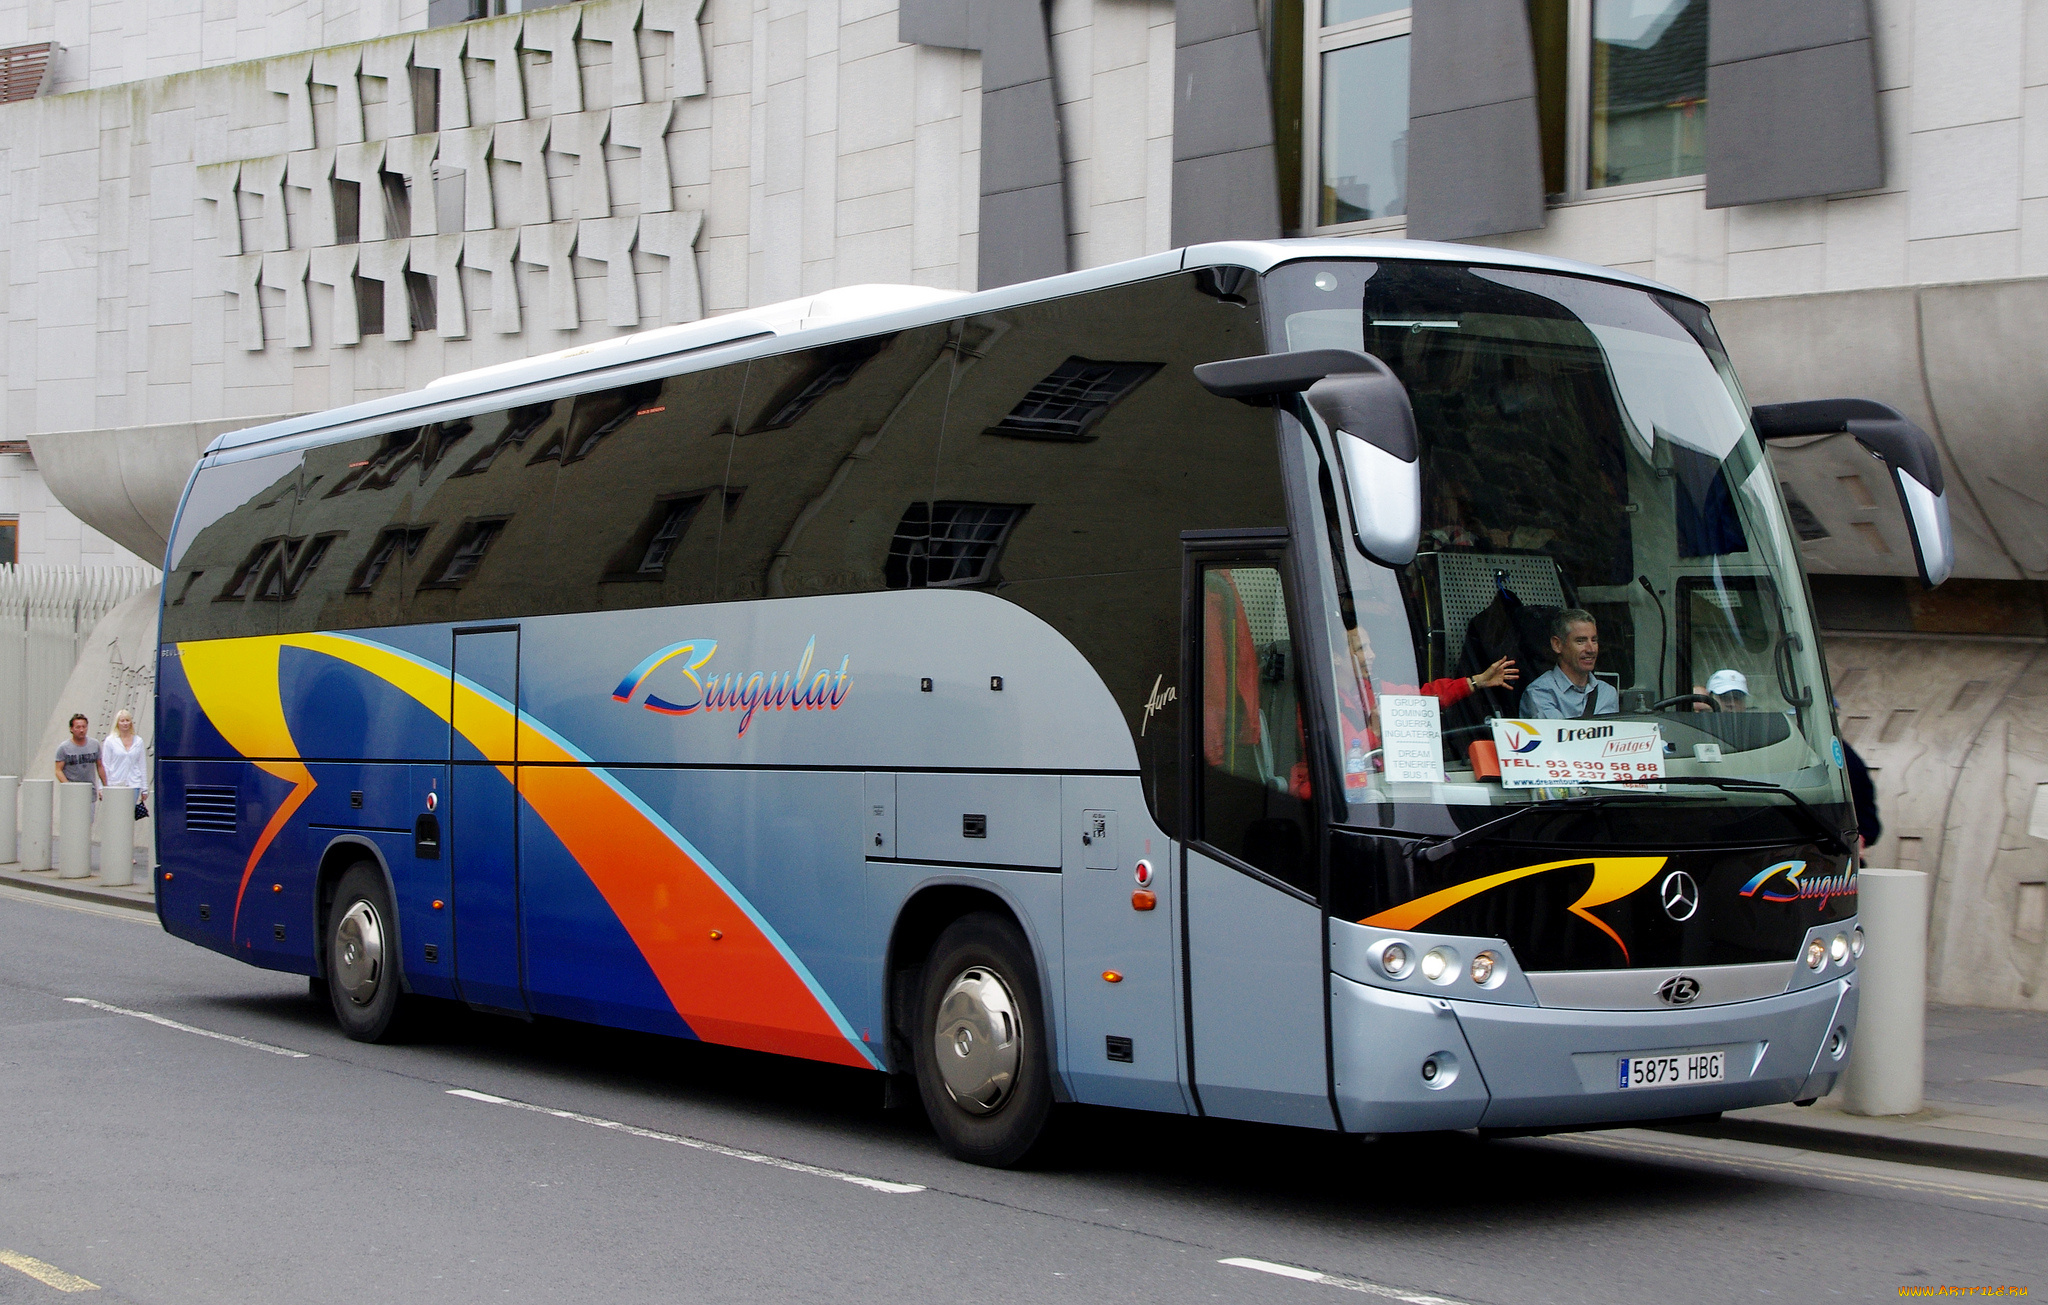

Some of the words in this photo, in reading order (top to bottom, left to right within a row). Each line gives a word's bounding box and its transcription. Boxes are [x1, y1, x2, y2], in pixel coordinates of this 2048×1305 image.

[1477, 557, 1516, 565] BEULAS
[612, 634, 853, 739] Brugulat
[1141, 673, 1178, 737] Aura
[1394, 698, 1427, 707] GRUPO
[1391, 709, 1435, 718] DOMINGO
[1395, 719, 1433, 728] GUERRA
[1384, 730, 1440, 739] INGLATERRA
[1557, 725, 1614, 743] Dream
[1609, 740, 1651, 753] Viatges
[1398, 749, 1431, 758] DREAM
[1392, 760, 1437, 769] TENERIFE
[1500, 758, 1541, 768] TEL.
[1545, 760, 1568, 768] 93
[1573, 760, 1604, 770] 630
[1610, 762, 1631, 771] 58
[1636, 763, 1658, 772] 88
[1403, 771, 1422, 779] BUS
[1424, 771, 1428, 779] 1
[1548, 769, 1573, 778] 92
[1576, 770, 1606, 780] 237
[1612, 772, 1633, 781] 39
[1738, 856, 1858, 912] Brugula
[1634, 1058, 1679, 1083] 5875
[1688, 1055, 1719, 1080] HBG
